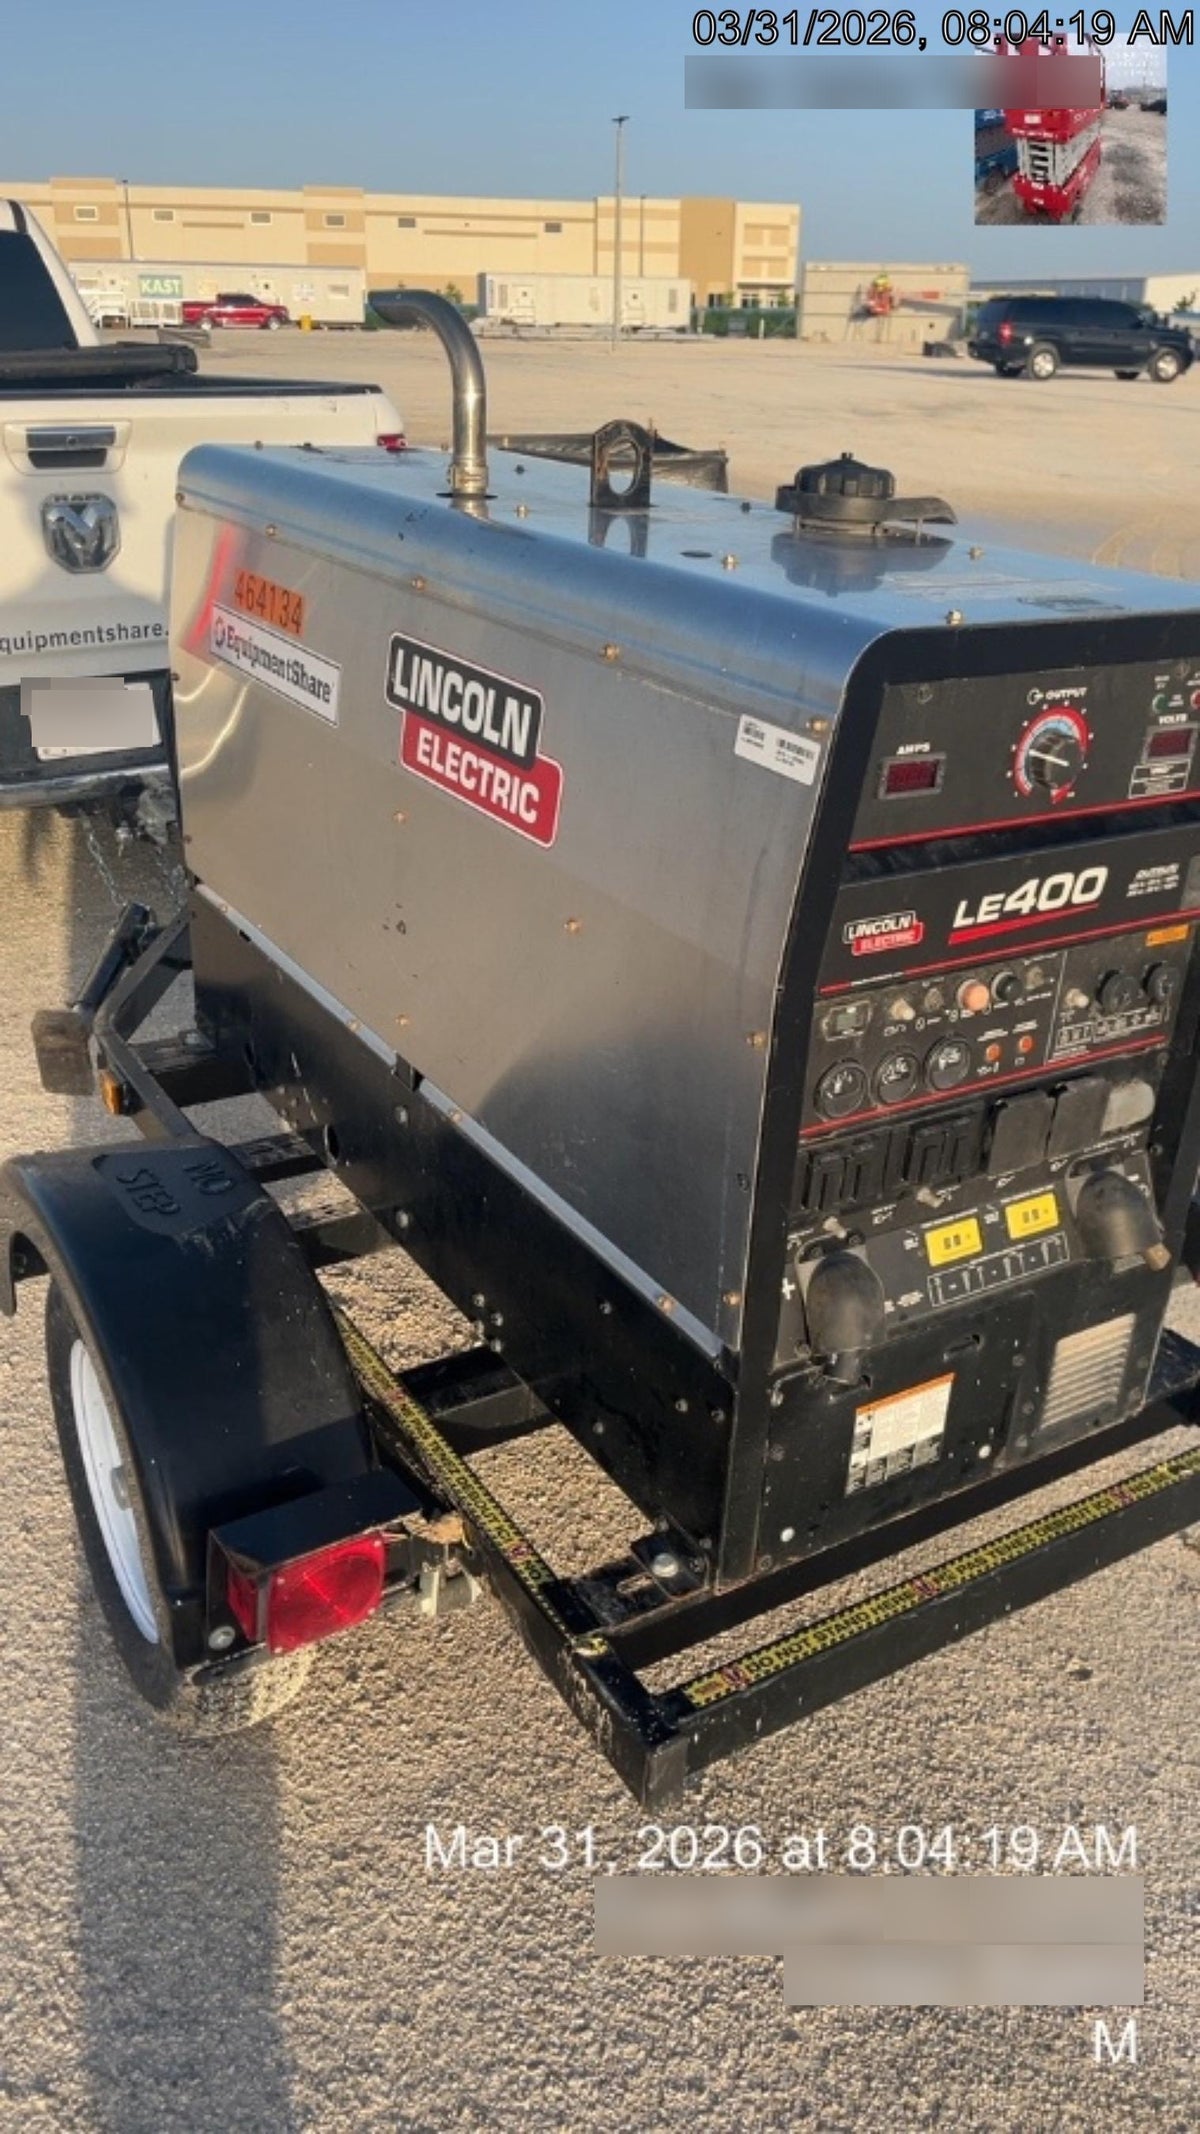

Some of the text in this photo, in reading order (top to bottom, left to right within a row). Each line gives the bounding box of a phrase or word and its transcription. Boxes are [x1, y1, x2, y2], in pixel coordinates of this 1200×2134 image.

[142, 279, 180, 295] KAST
[235, 571, 304, 634] 464134
[227, 625, 331, 703] EquipmentShare
[1045, 687, 1087, 701] OUTPUT
[393, 648, 533, 757] LINCOLN
[417, 727, 540, 824] ELECTRIC
[896, 742, 931, 755] AMPS
[848, 915, 912, 940] LINCOLN
[953, 866, 1109, 928] LE400
[116, 1168, 182, 1214] STEP
[745, 1654, 774, 1675] DO
[774, 1636, 812, 1662] NOT
[812, 1610, 872, 1641] STAND
